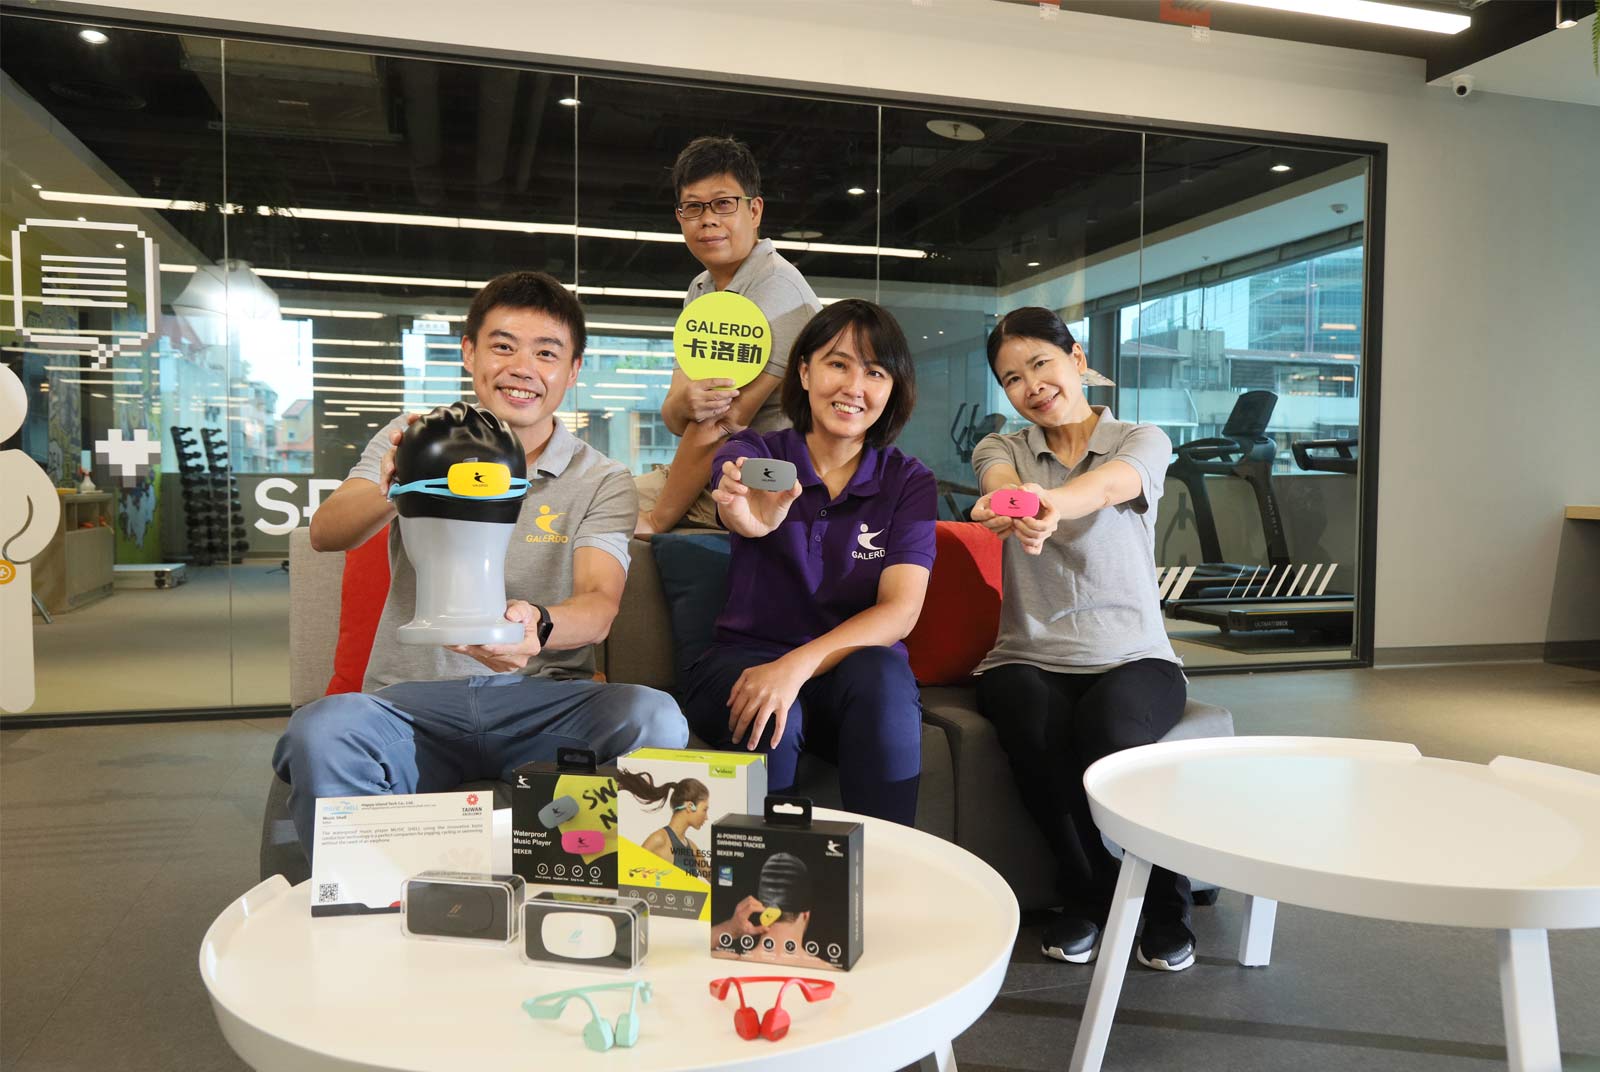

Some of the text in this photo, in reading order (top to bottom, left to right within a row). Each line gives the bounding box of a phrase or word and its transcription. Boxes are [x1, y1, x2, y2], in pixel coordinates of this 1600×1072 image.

[686, 319, 764, 339] GALERDO
[683, 338, 762, 364] 卡洛動
[526, 534, 568, 544] GALERDO
[851, 549, 886, 560] GALERD
[582, 779, 618, 810] SW
[599, 808, 618, 830] N
[513, 830, 547, 838] Waterproof
[716, 833, 763, 842] AI-POWERED AUDIO
[532, 838, 552, 847] Player
[716, 839, 765, 849] SWIMMING TRACKER
[670, 847, 712, 858] WIRELESS
[683, 857, 712, 868] CONDU
